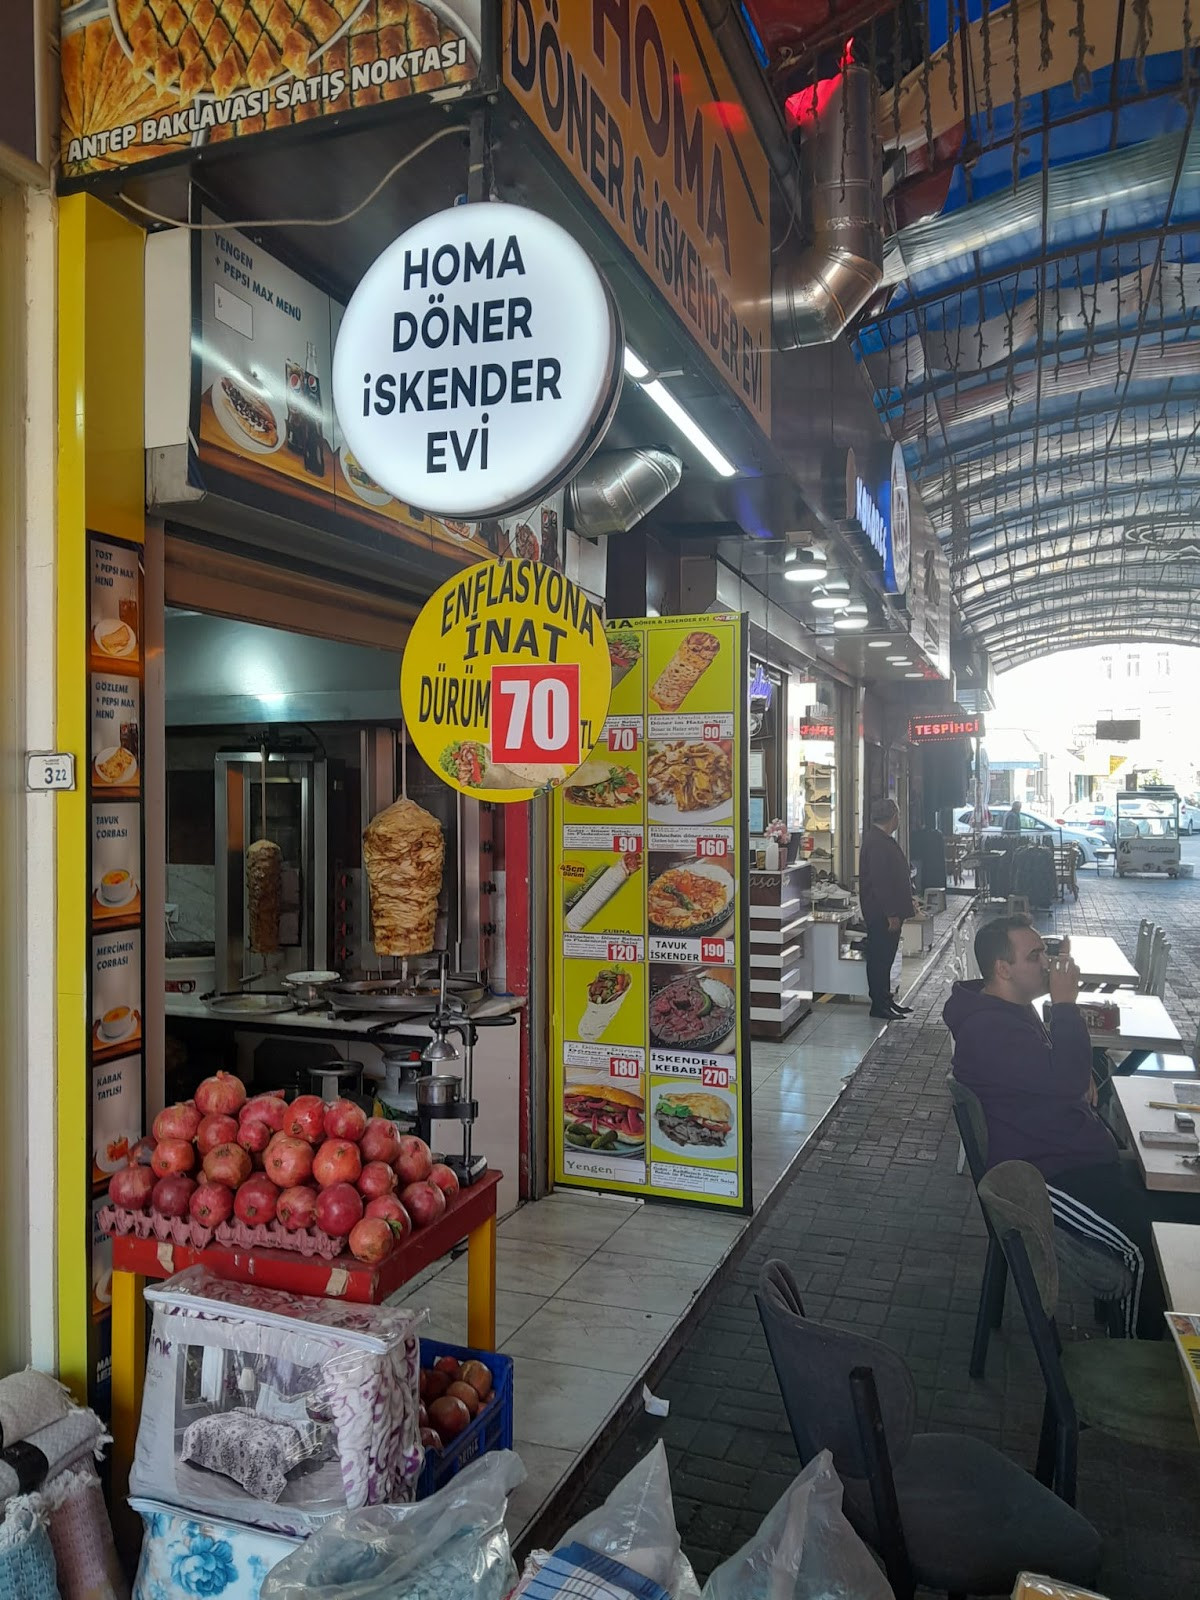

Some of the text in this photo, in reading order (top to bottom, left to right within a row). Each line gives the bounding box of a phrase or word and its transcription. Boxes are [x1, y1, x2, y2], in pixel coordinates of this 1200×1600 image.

[67, 40, 467, 163] ANTEP BAKLAVASI SATIŞ NOKTASI
[511, 0, 626, 223] DÖNER
[632, 156, 649, 255] &
[214, 232, 253, 270] YENGEN
[404, 235, 525, 291] HOMA
[224, 261, 250, 288] PEPSI
[252, 280, 274, 304] MAX
[276, 298, 301, 322] MENÜ
[393, 294, 533, 352] DÖNER
[426, 413, 489, 474] EVİ
[95, 549, 113, 562] TOST
[100, 564, 119, 576] PEPSI
[119, 566, 135, 579] MAX
[95, 574, 114, 588] MENÜ
[441, 560, 602, 647] ENFLASYONA
[463, 612, 567, 663] İNAT
[95, 682, 129, 694] GÖZLEME
[101, 696, 120, 708] PEPSI
[120, 698, 135, 709] MAX
[419, 663, 491, 728] DÜRÜM
[500, 678, 570, 750] 70
[95, 708, 114, 720] MENÜ
[612, 729, 634, 750] 70
[704, 726, 719, 739] 90
[96, 816, 119, 826] TAVUK
[96, 828, 128, 840] ÇORBASI
[619, 837, 637, 852] 90
[699, 840, 725, 856] 160
[97, 941, 134, 956] MERCİMEK
[611, 945, 635, 960] 120
[656, 941, 687, 950] TAVUK
[703, 943, 724, 957] 190
[650, 950, 699, 961] İSKENDER
[97, 957, 129, 970] ÇORBASI
[652, 1053, 717, 1066] İSKENDER
[612, 1060, 637, 1076] 180
[655, 1064, 702, 1074] KEBABI
[97, 1072, 122, 1087] KABAK
[704, 1069, 727, 1086] 270
[566, 1161, 613, 1174] Yengen
